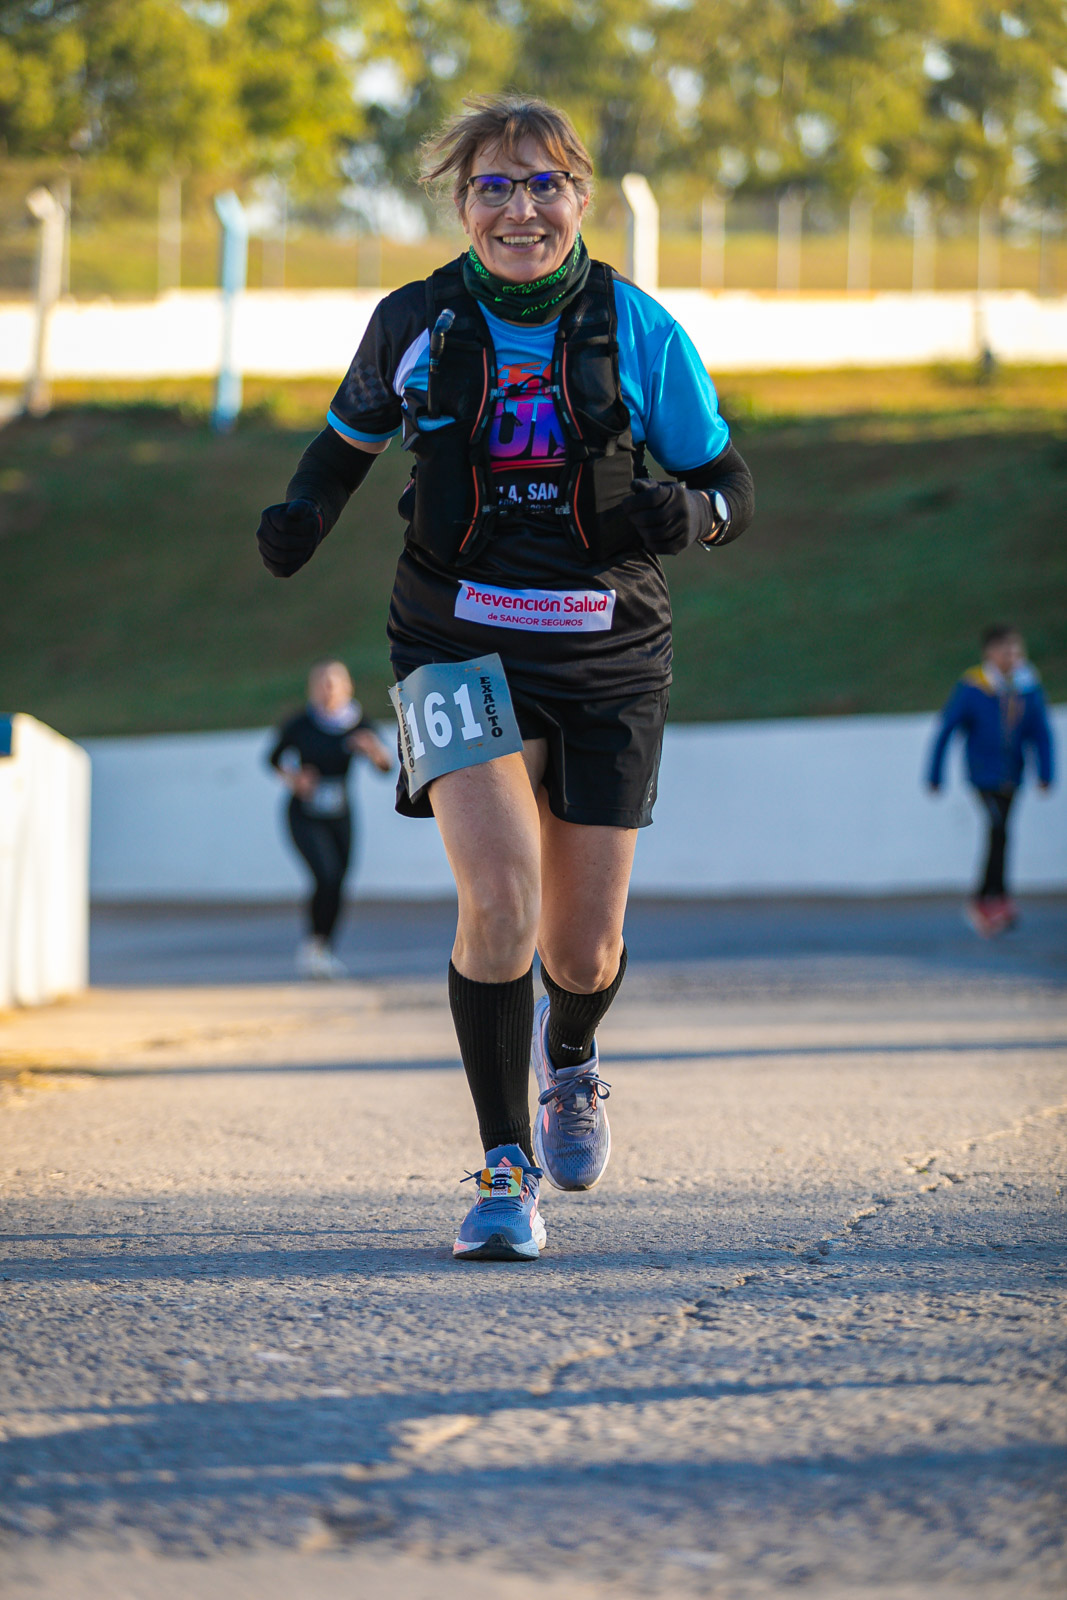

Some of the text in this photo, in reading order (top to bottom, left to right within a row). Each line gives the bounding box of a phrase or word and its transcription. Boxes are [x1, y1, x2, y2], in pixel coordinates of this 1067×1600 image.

[466, 586, 608, 613] Prevención Salud
[487, 613, 583, 627] de SANCOR SEGUROS
[405, 683, 484, 760] 161
[479, 676, 503, 738] EXACTO
